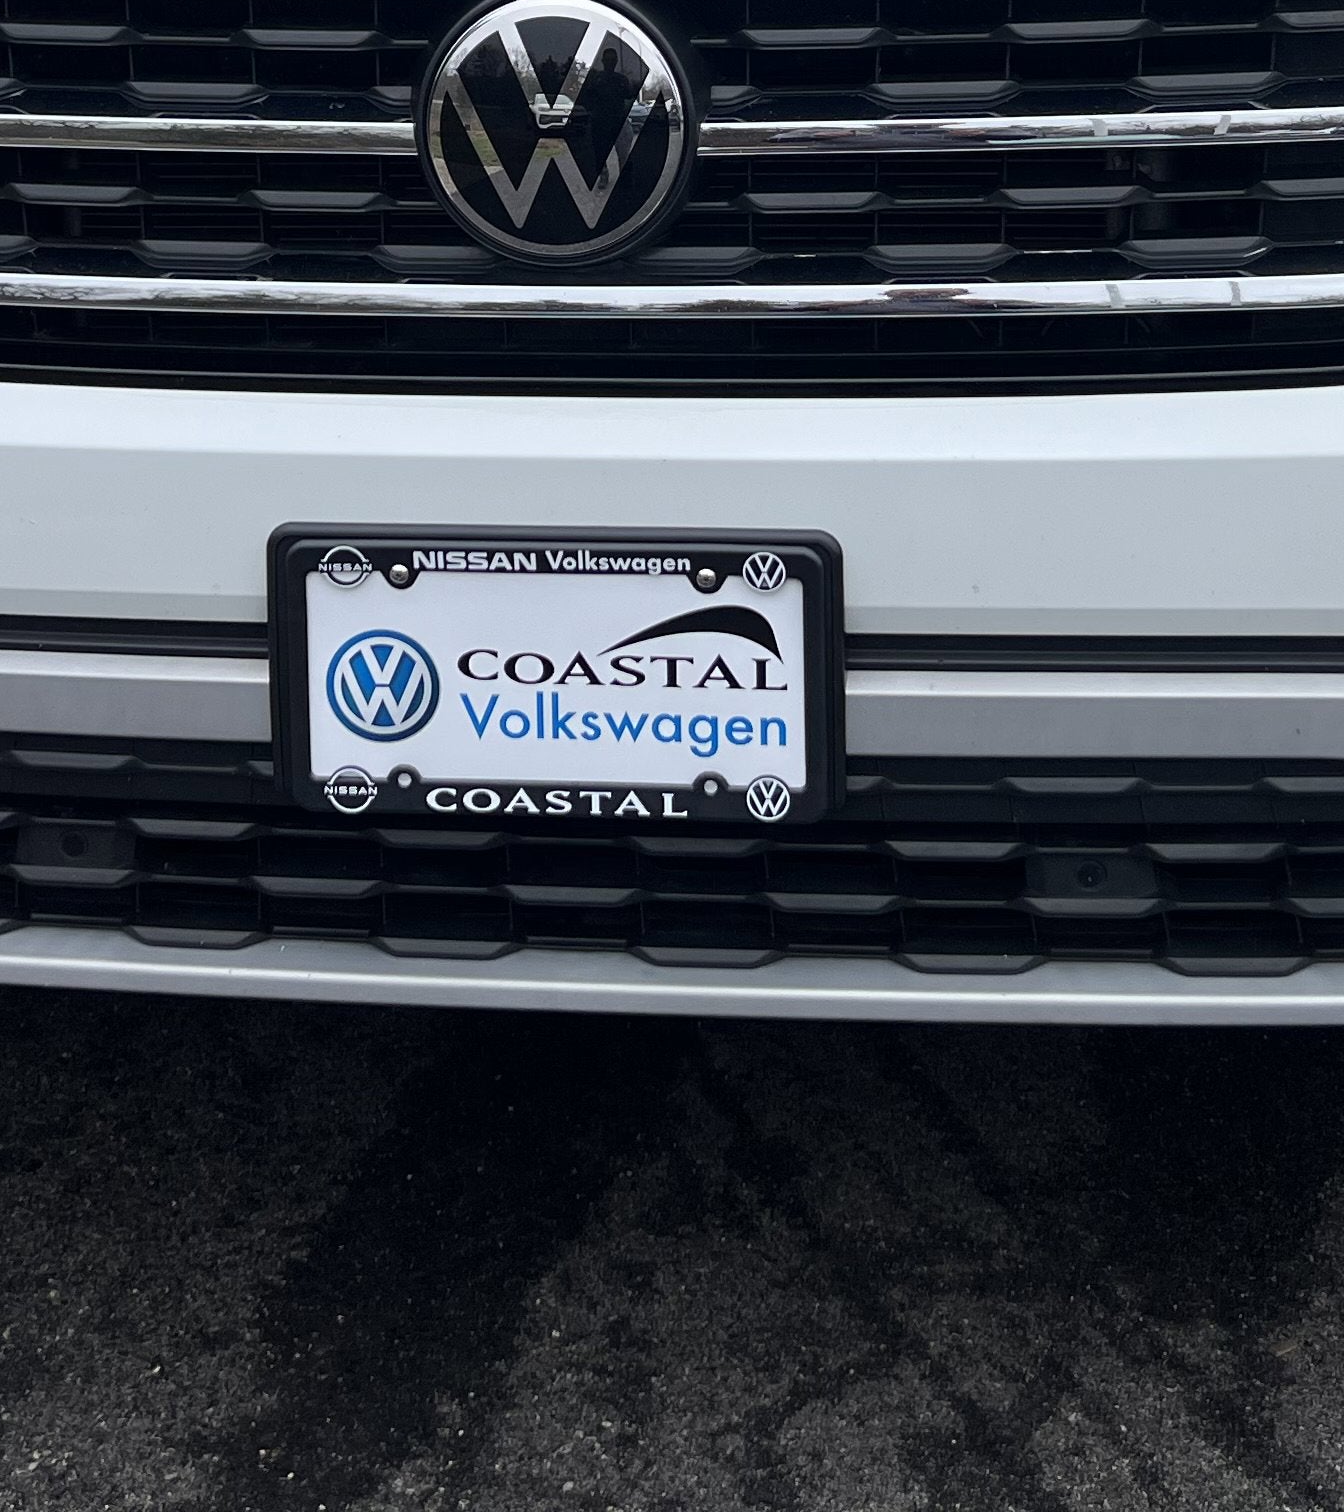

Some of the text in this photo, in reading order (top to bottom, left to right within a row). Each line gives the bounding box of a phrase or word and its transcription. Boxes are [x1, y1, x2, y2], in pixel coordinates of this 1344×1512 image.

[439, 11, 675, 231] VW
[318, 563, 373, 572] NISSAN
[413, 550, 691, 575] NISSAN Volkswagen
[744, 553, 786, 592] VW
[333, 636, 434, 734] VW
[457, 648, 788, 691] COASTAL
[460, 691, 788, 758] Volkswagen
[324, 786, 378, 796] NISSAN
[426, 787, 689, 818] COASTAL
[748, 778, 790, 820] VW
